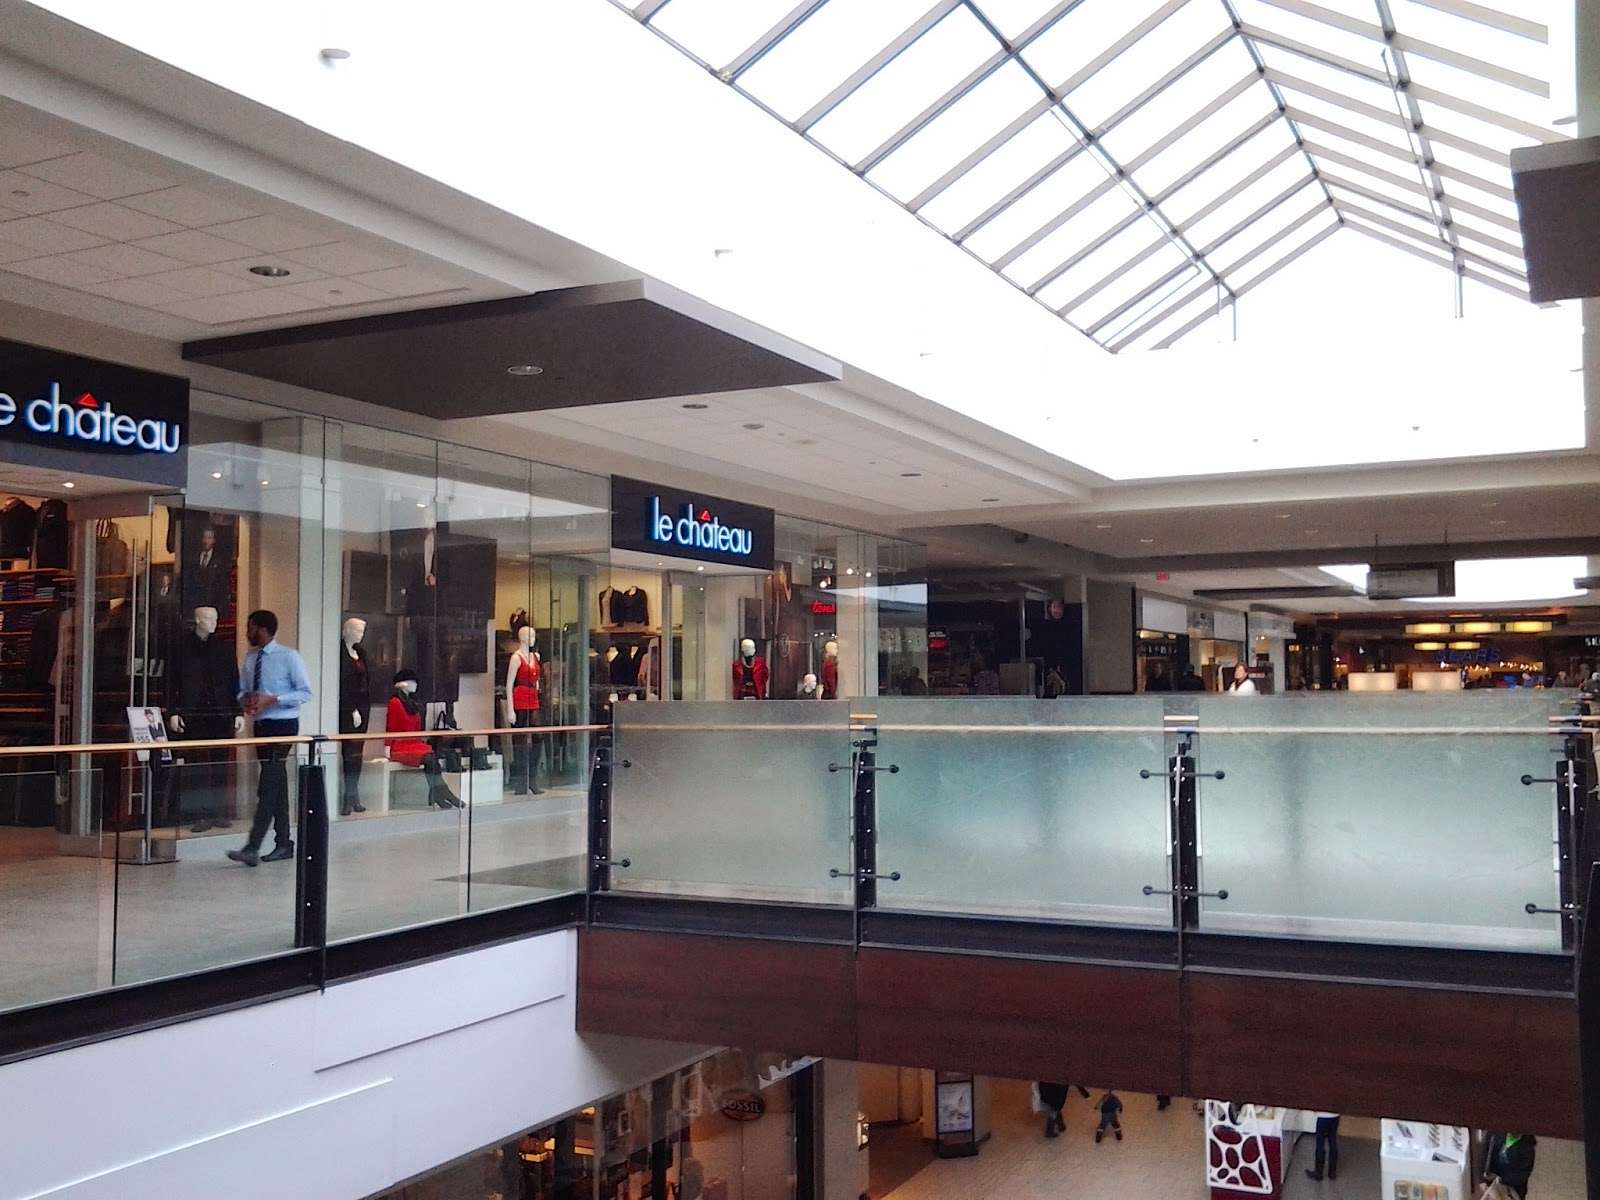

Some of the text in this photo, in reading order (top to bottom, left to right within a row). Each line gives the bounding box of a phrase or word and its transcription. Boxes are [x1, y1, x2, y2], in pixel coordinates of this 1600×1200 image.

[27, 382, 180, 453] château
[653, 495, 752, 554] le château
[1436, 648, 1501, 661] SEARS
[723, 1099, 761, 1113] FOSSIL
